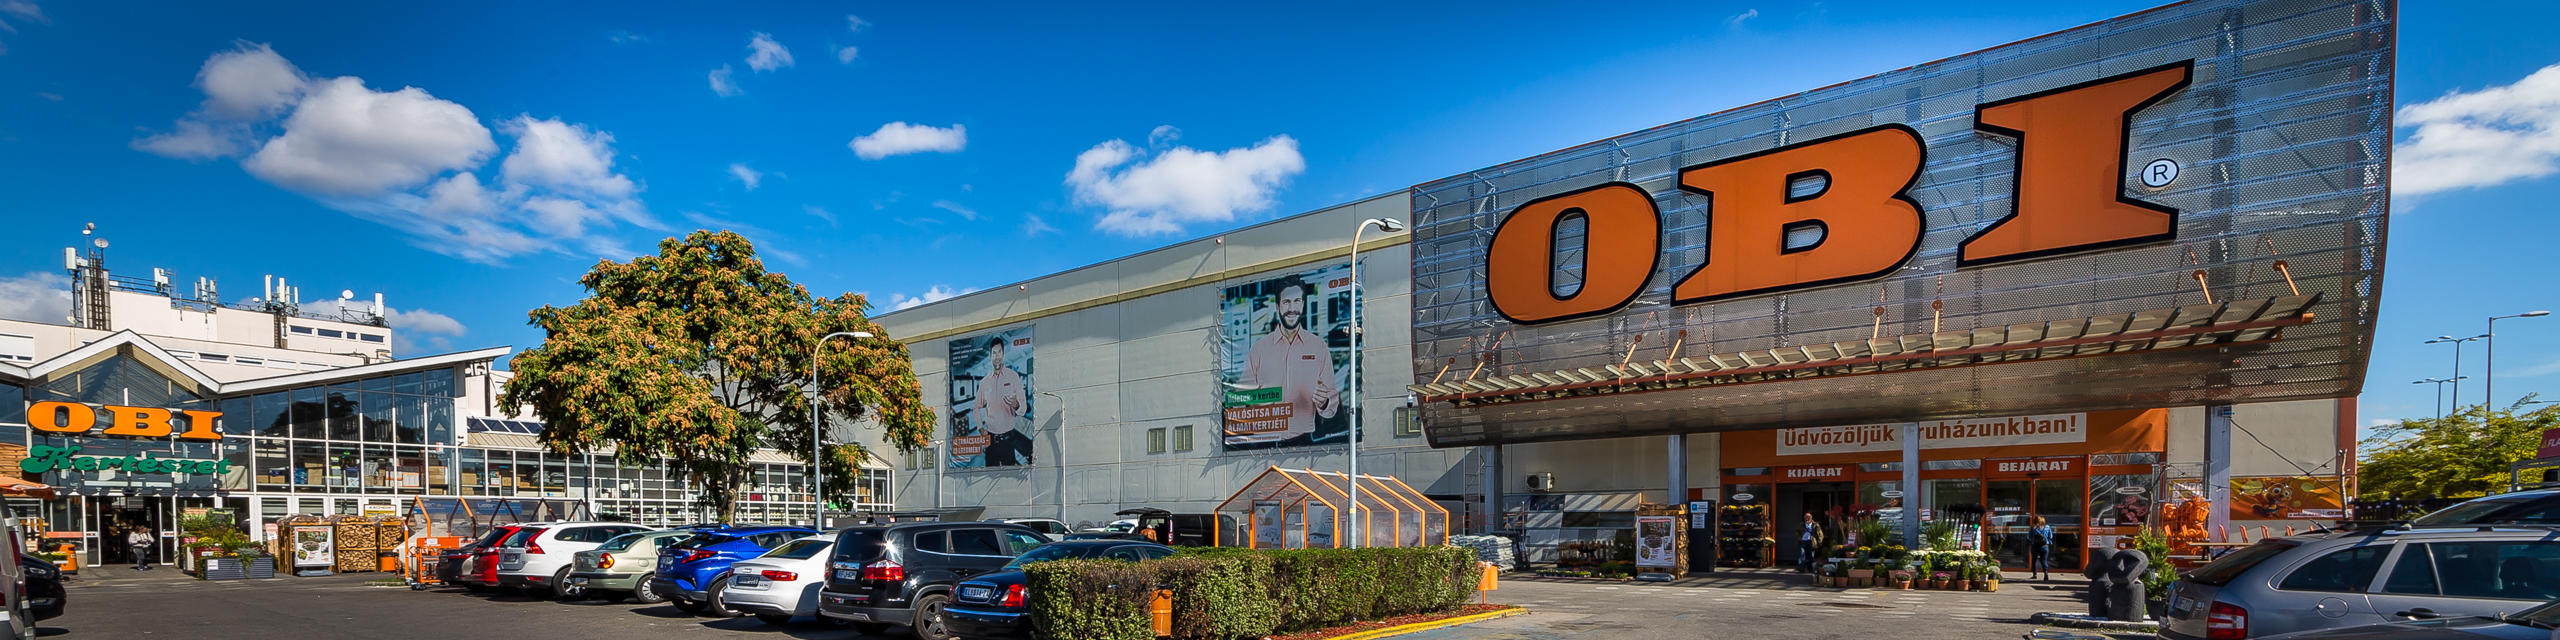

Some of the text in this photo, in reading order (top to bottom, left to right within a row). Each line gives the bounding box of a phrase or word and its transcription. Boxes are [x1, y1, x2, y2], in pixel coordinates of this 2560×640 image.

[1486, 58, 2195, 325] OBI
[1328, 277, 1349, 288] OB
[1013, 338, 1030, 346] OBI
[1228, 405, 1291, 420] VALÓSÍTSA MEG
[27, 401, 224, 440] OBI
[1252, 418, 1287, 431] KERTJÉT!
[1784, 415, 2076, 447] Üdvözöljük ruházunkban!
[20, 445, 232, 474] Kertészet
[1998, 459, 2070, 472] BEJÁRAT
[1787, 465, 1843, 478] KIJÁRAT
